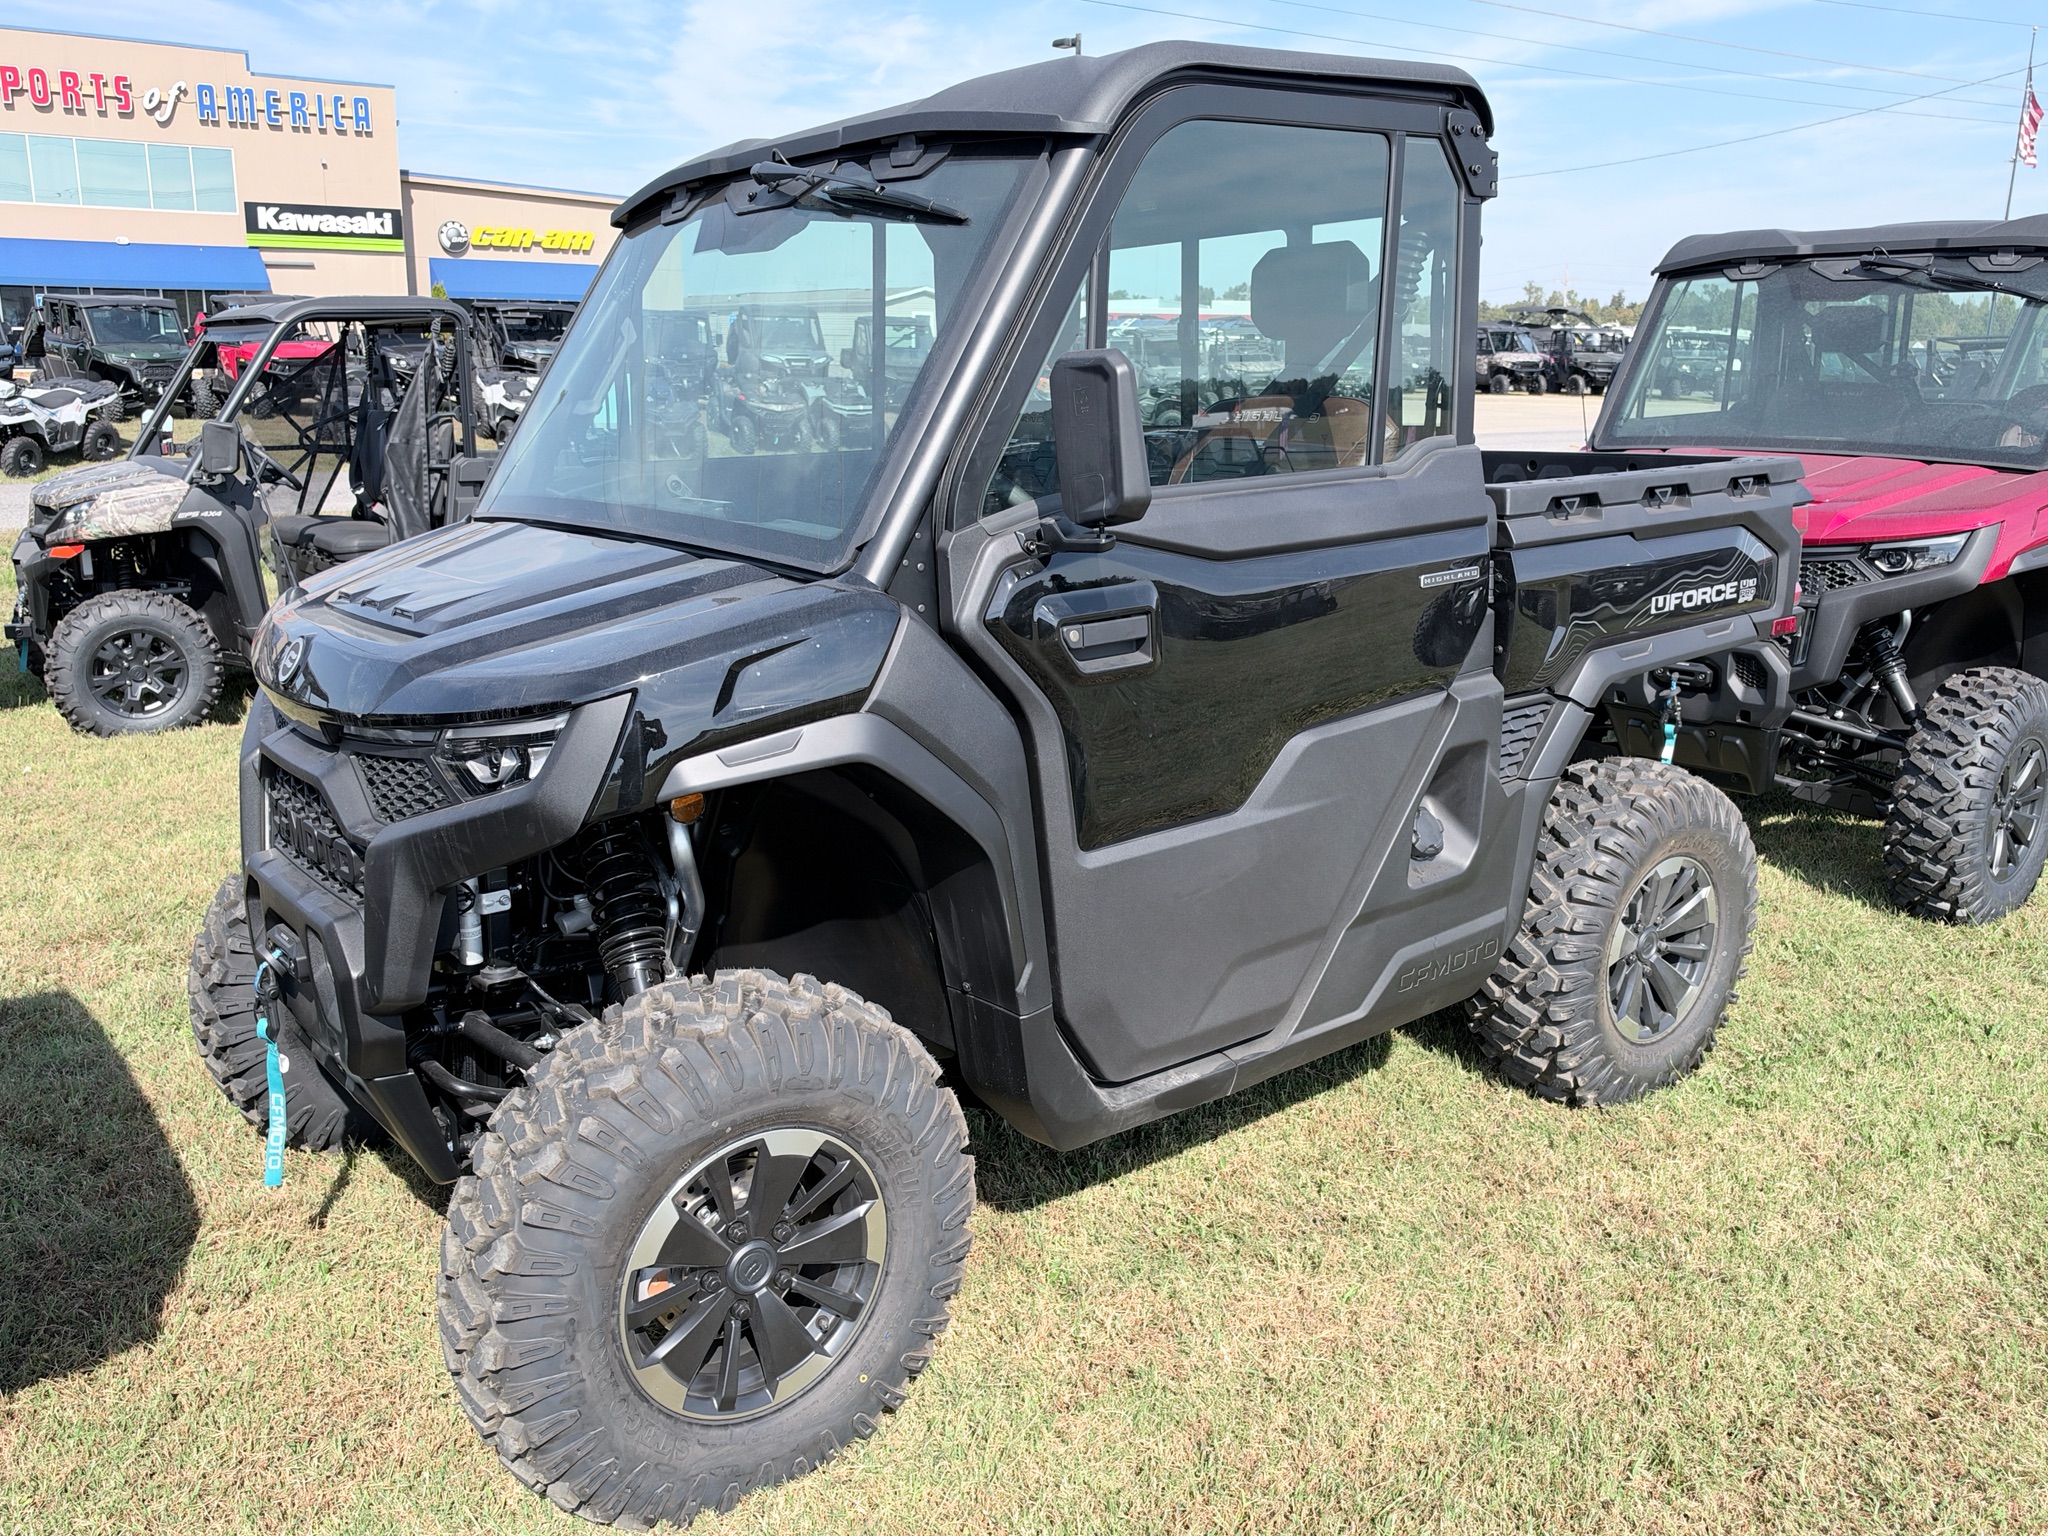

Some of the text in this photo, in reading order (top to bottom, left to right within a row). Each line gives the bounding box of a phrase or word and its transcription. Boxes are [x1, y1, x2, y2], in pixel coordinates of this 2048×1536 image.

[143, 80, 187, 122] of
[196, 83, 373, 132] AMERICA
[256, 206, 393, 235] Kawasaki
[470, 226, 595, 250] can-am
[177, 511, 200, 519] EPS
[1424, 569, 1478, 584] HIGHLAND
[1740, 577, 1757, 588] U10
[1650, 581, 1738, 615] UFORCE
[1398, 937, 1499, 993] CFMOTO
[267, 1092, 285, 1171] CFMOTO
